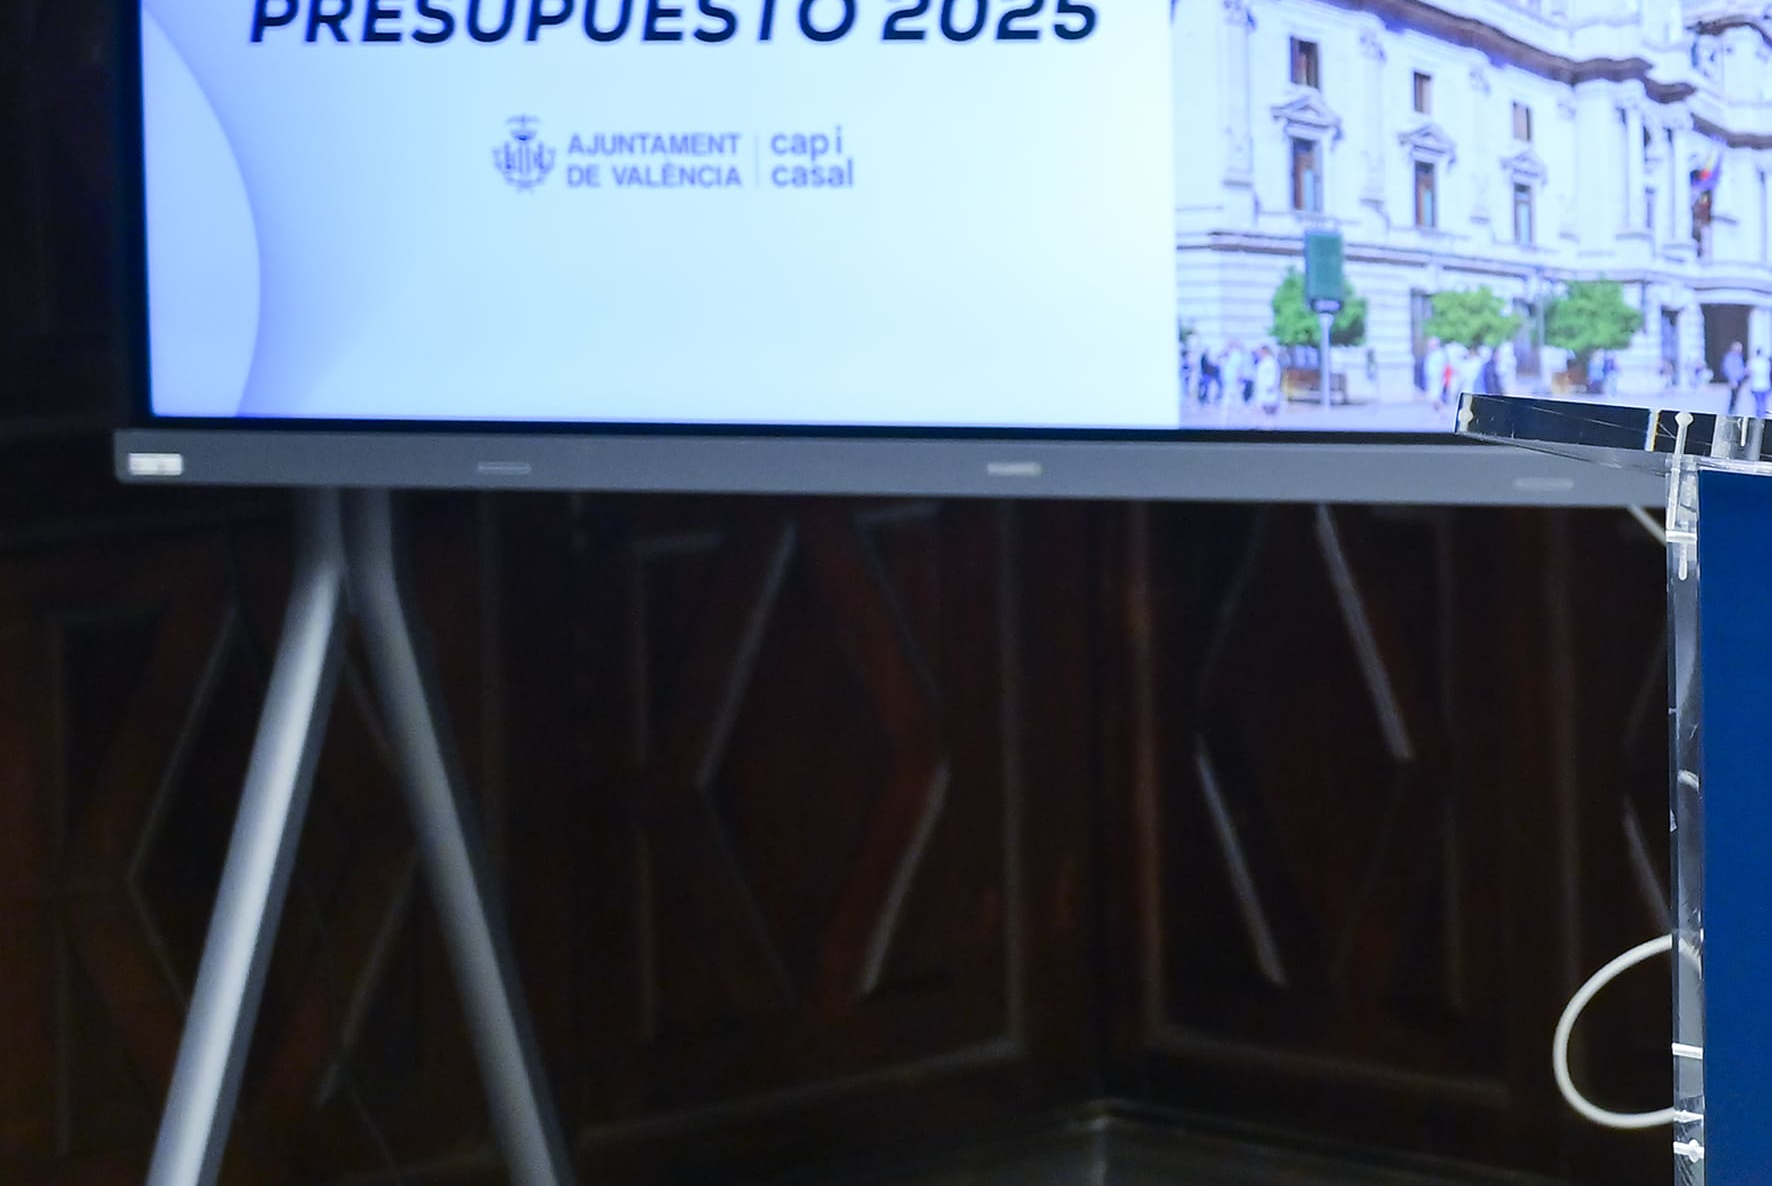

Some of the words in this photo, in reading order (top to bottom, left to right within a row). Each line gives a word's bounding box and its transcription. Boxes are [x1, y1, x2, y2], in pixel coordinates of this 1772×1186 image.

[567, 133, 742, 155] AJUNTAMENT
[770, 133, 829, 161] cap
[836, 125, 843, 154] i
[568, 166, 601, 187] DE
[612, 160, 742, 187] VALÈNCIA
[771, 158, 854, 188] casal
